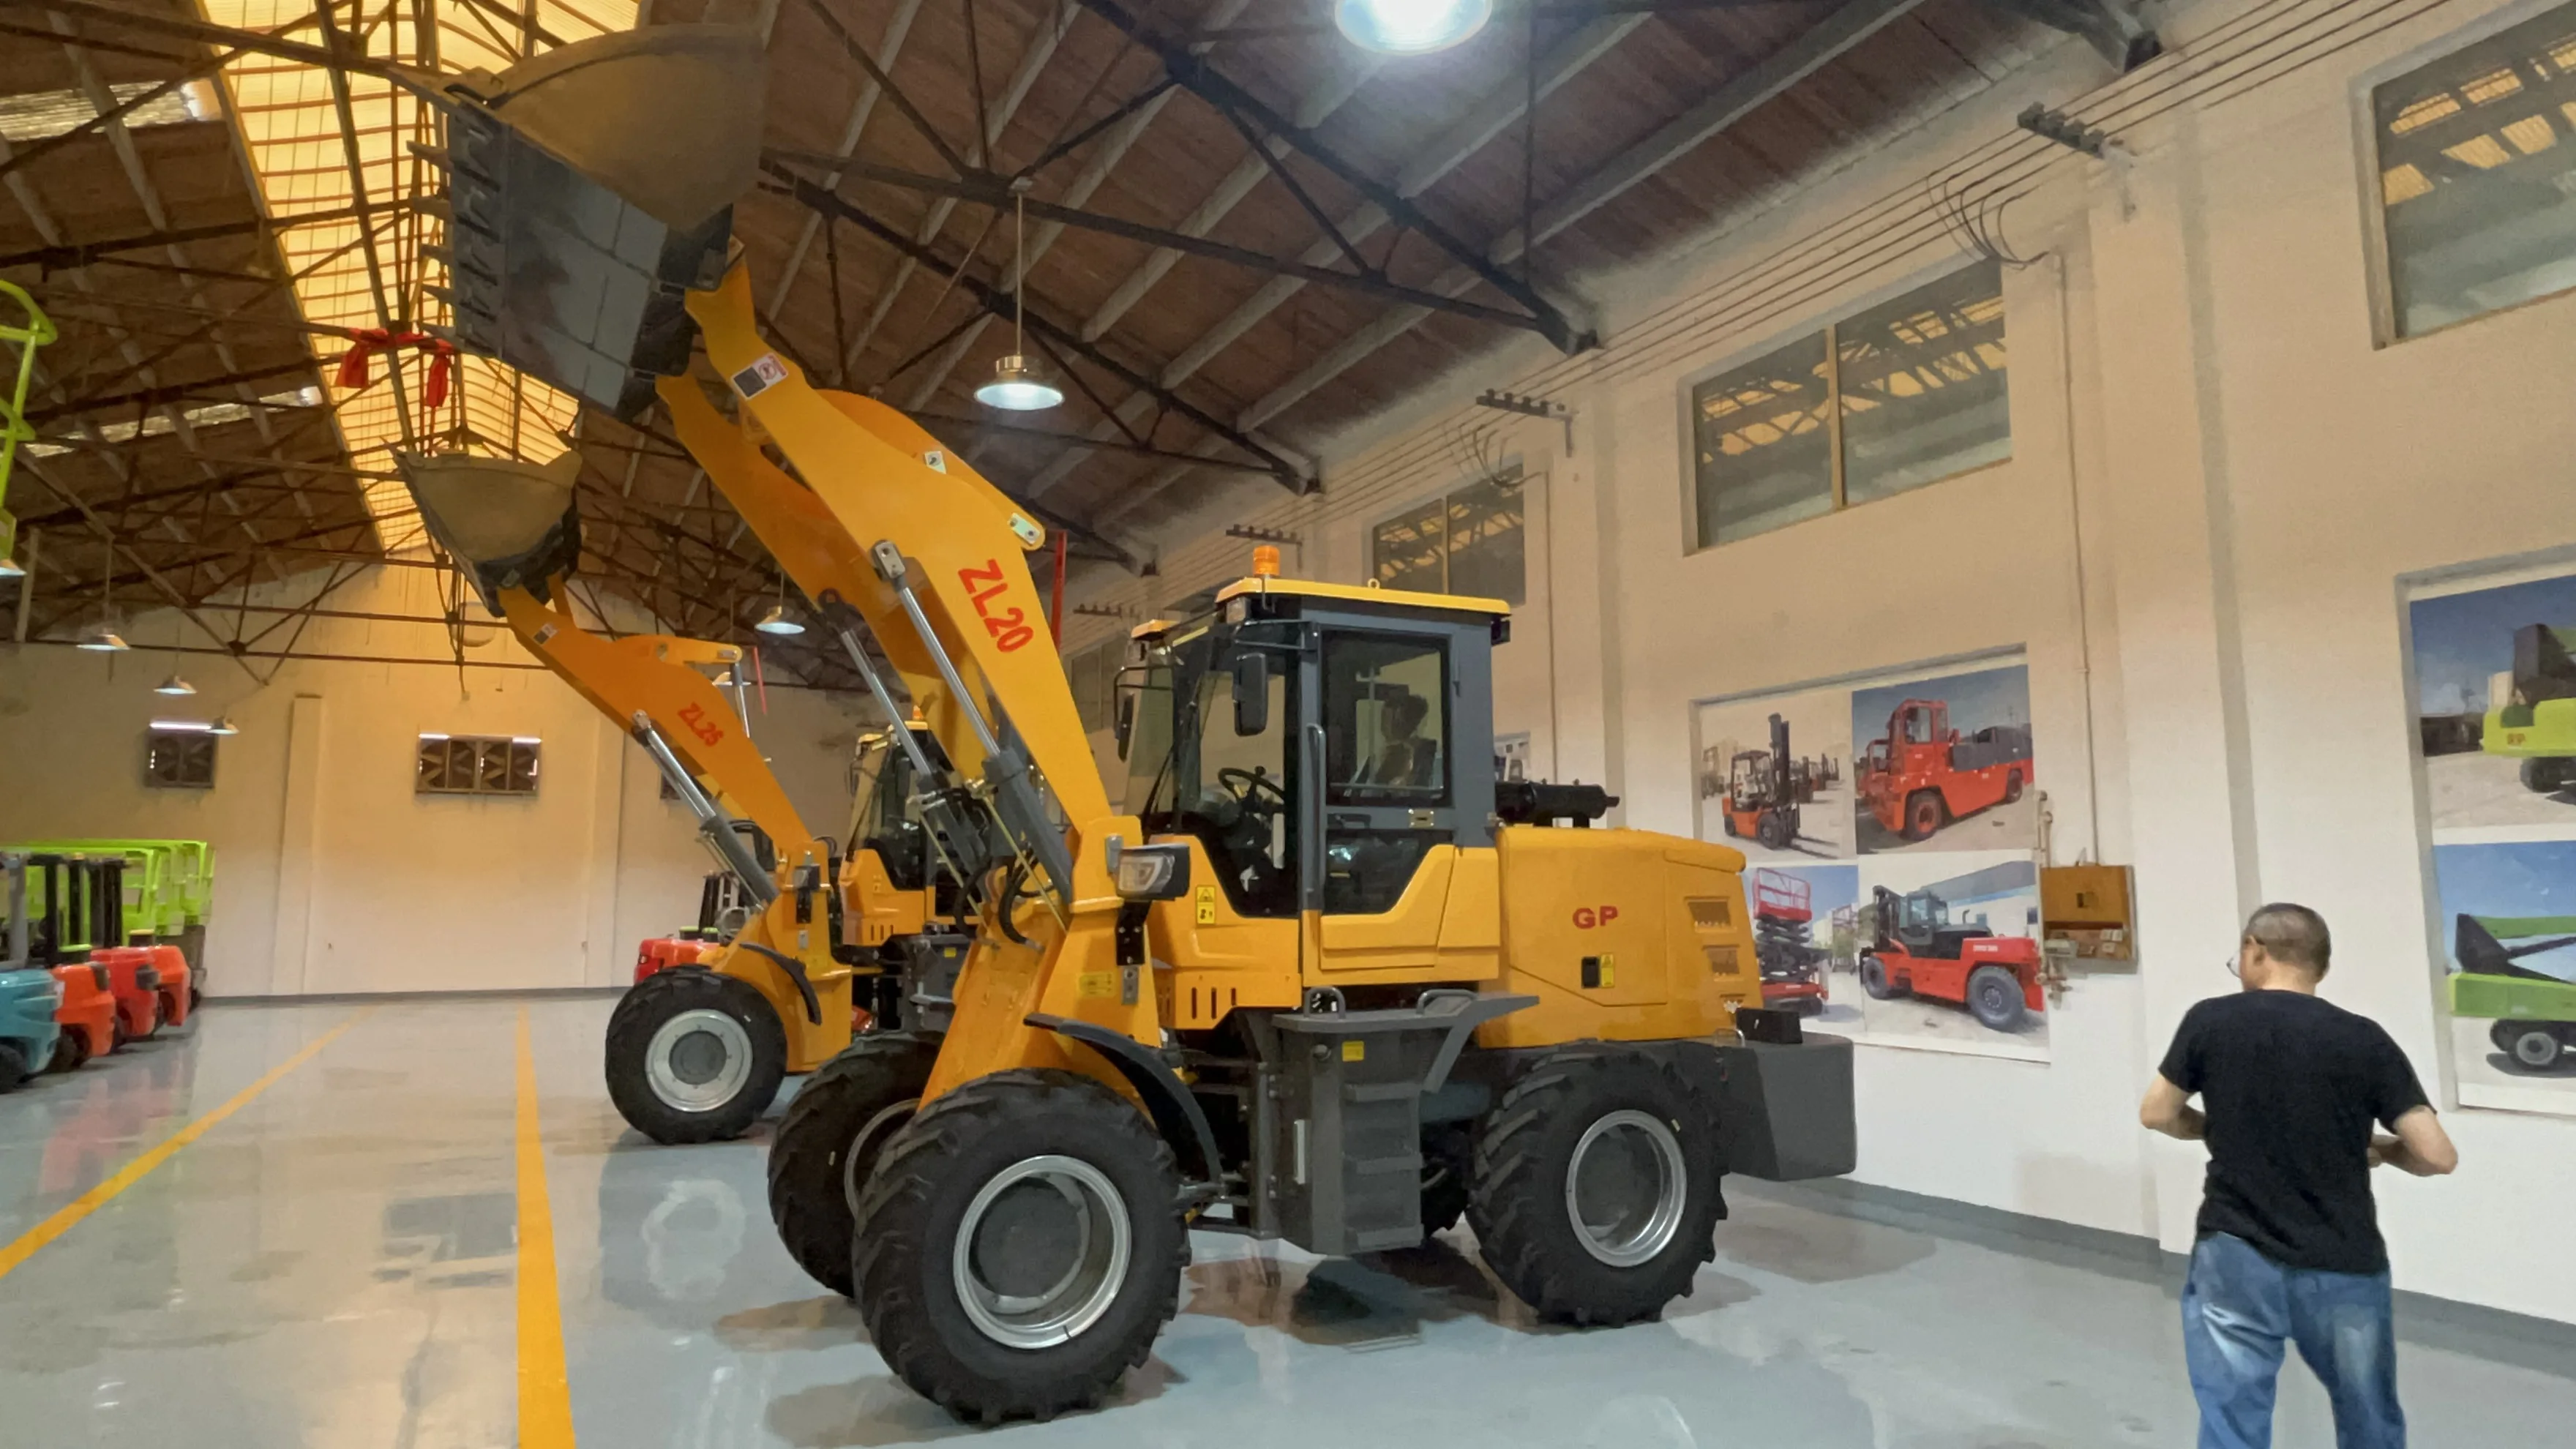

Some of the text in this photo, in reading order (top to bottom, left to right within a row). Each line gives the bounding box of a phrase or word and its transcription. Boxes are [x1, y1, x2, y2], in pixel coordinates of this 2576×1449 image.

[958, 559, 1034, 653] ZL20
[678, 701, 724, 747] ZL25
[1573, 906, 1618, 929] GP
